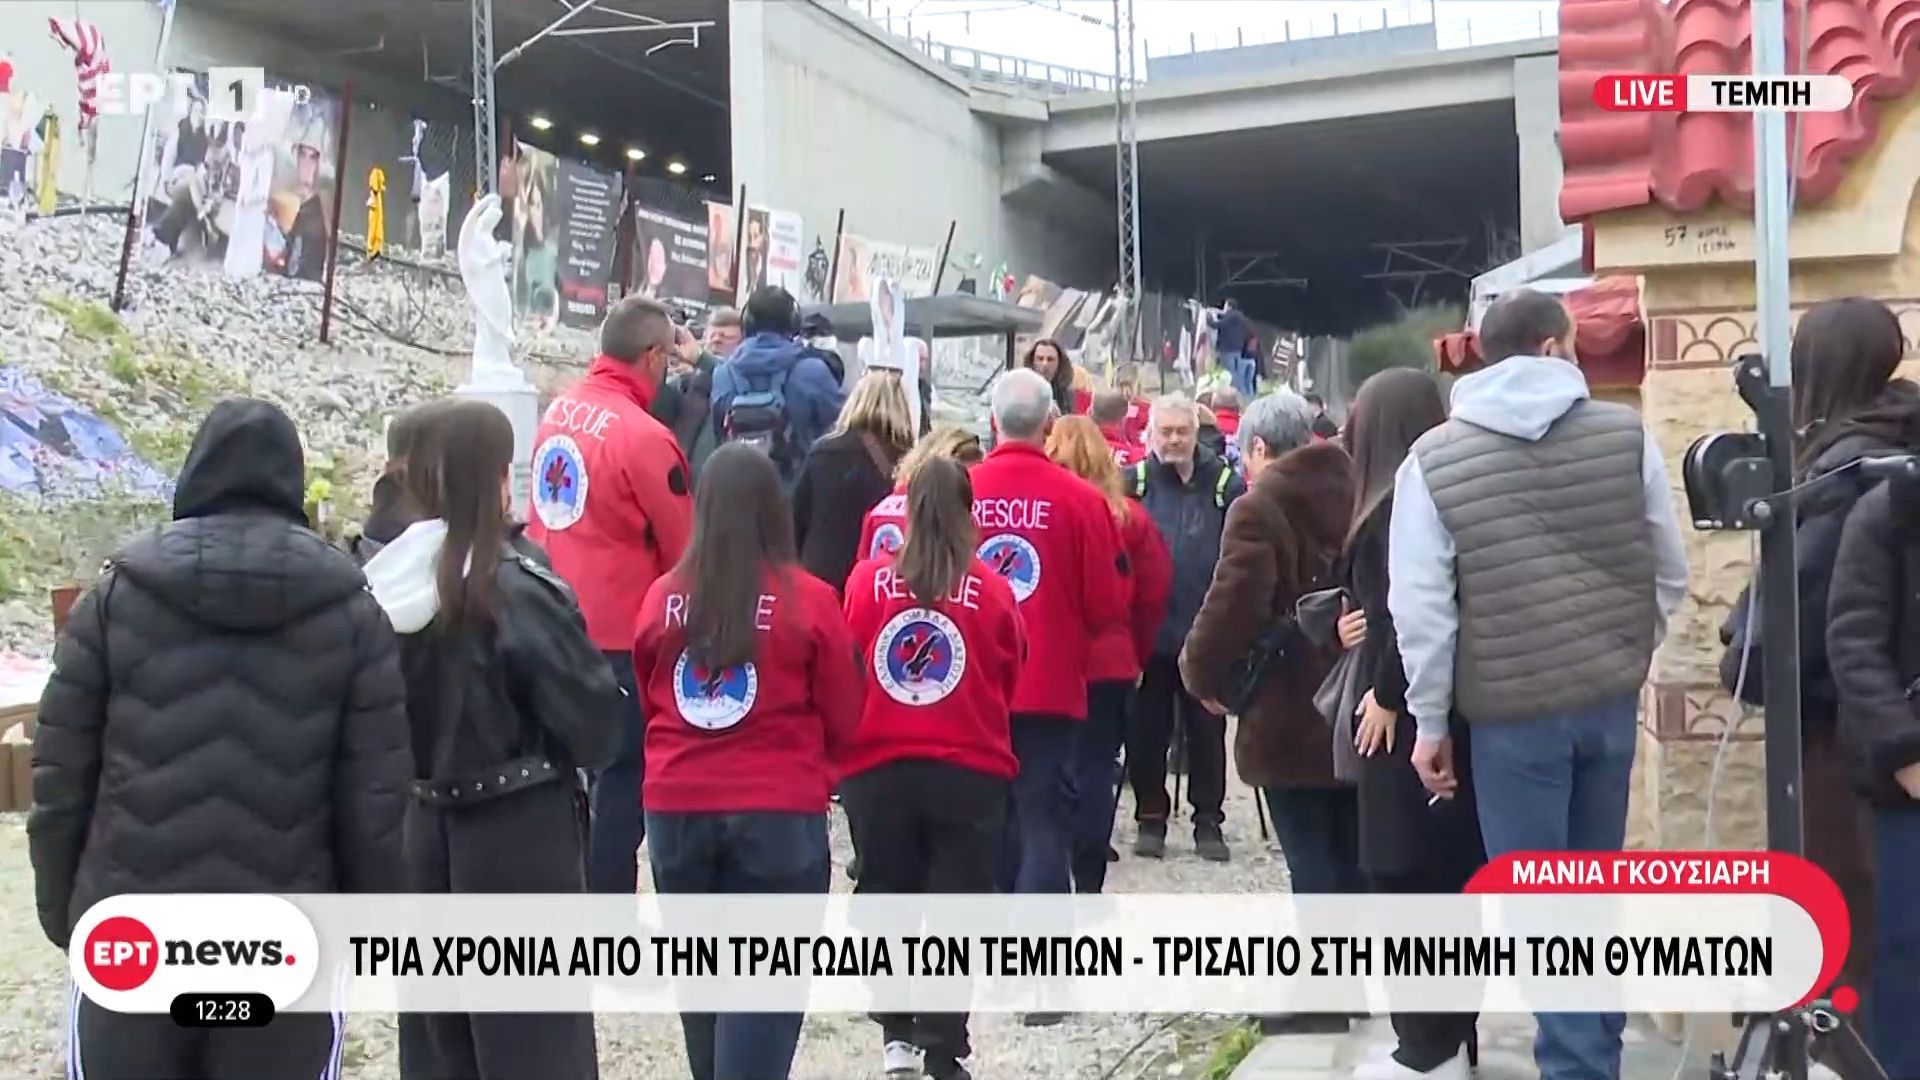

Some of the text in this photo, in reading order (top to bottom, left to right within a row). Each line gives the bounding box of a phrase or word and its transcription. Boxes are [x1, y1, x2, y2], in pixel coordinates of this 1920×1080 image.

[1664, 224, 1687, 248] 57
[971, 498, 1052, 530] RESCUE
[873, 566, 983, 611] REUE
